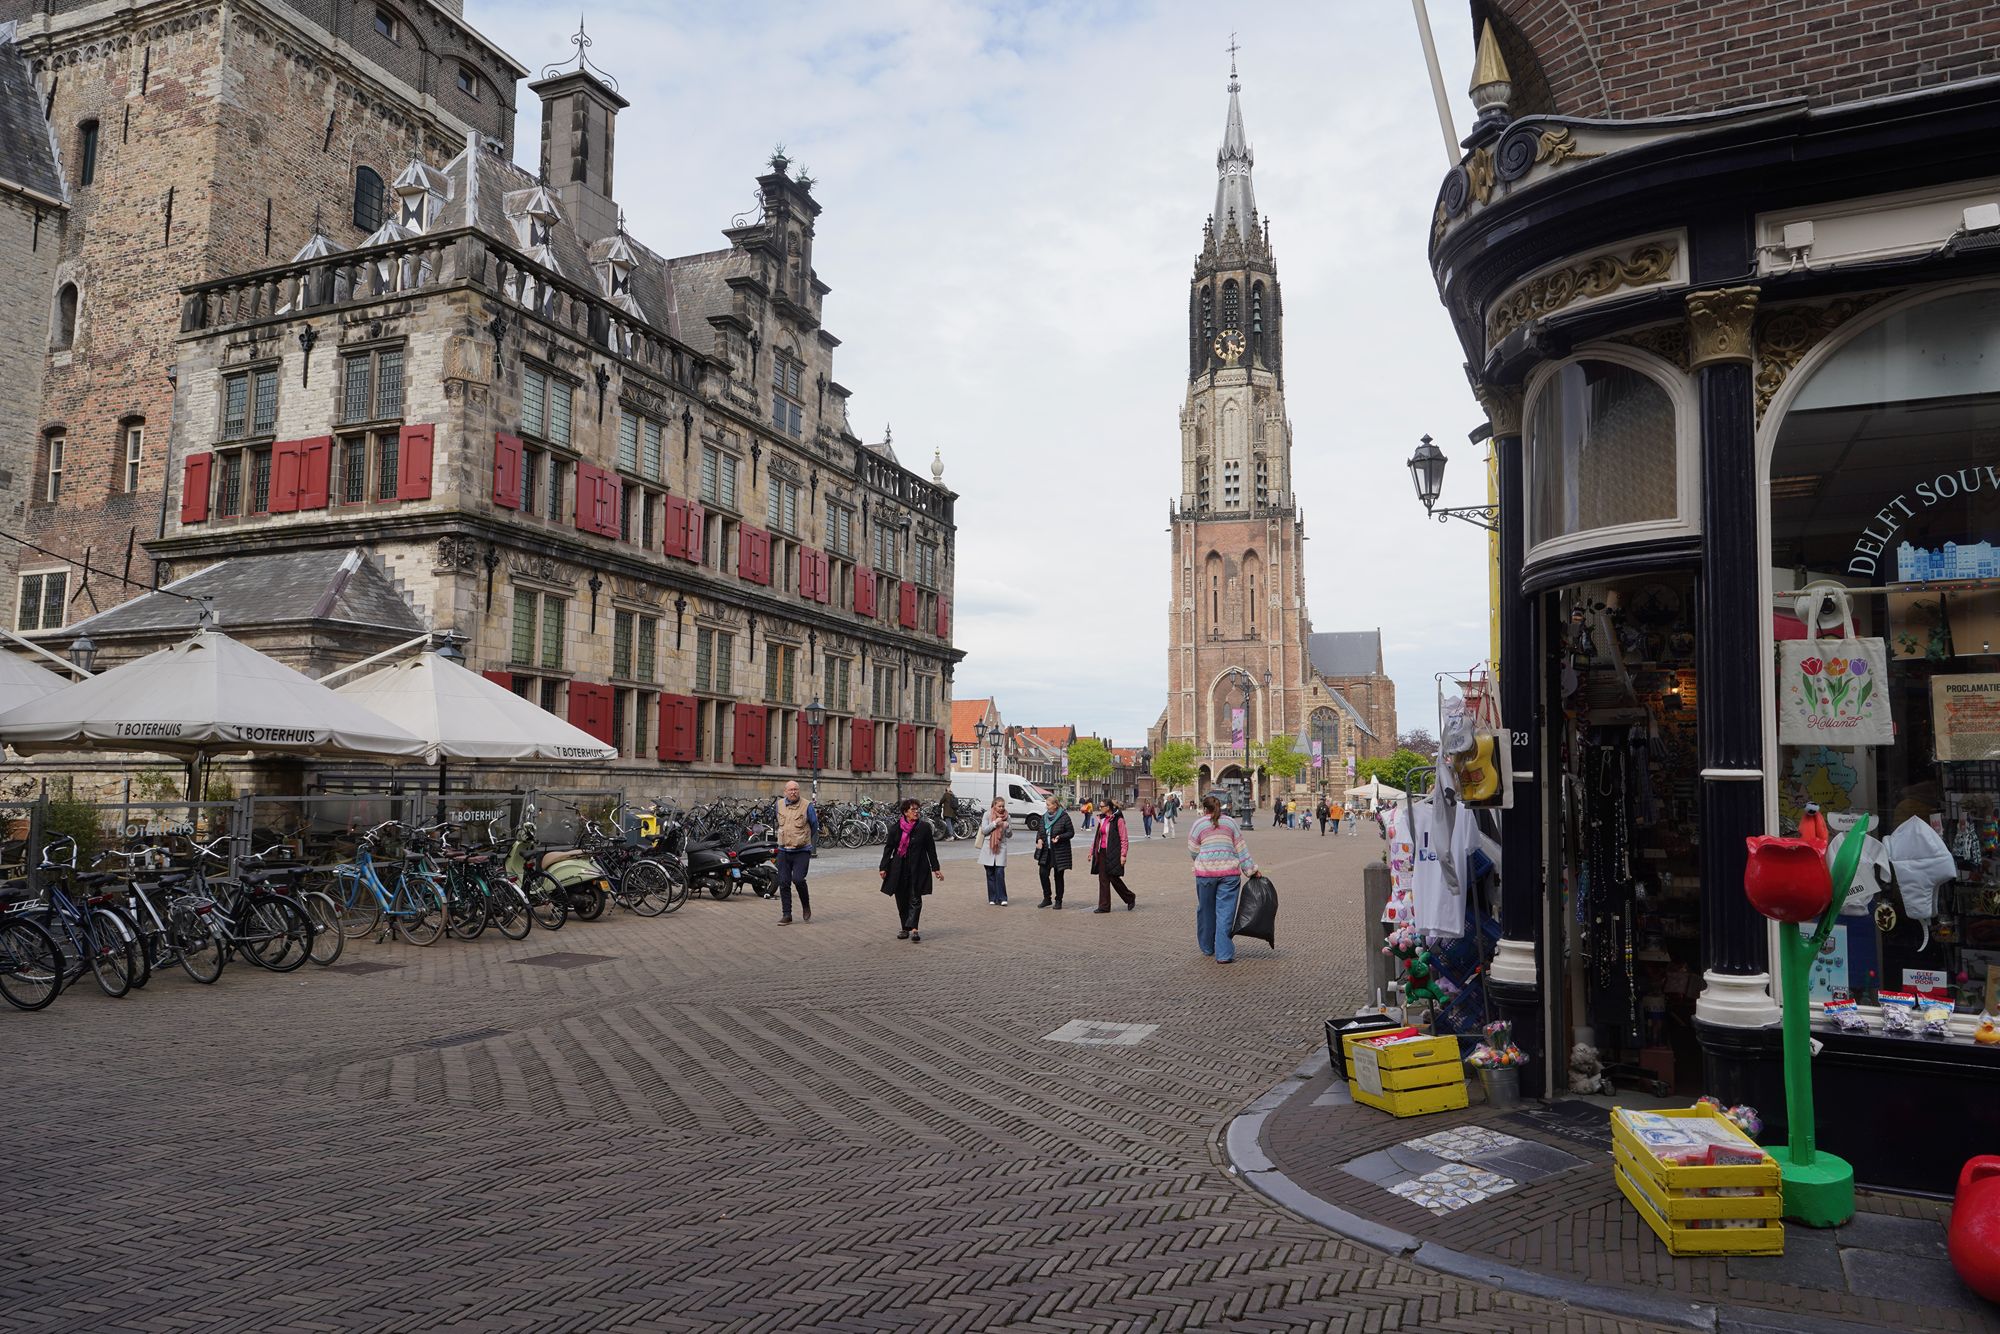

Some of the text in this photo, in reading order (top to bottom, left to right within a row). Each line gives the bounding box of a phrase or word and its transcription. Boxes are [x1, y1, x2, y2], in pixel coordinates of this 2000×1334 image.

[1848, 495, 1916, 576] DELFT
[1807, 714, 1863, 730] Holland
[124, 723, 182, 736] BOTERHUIS
[247, 726, 315, 742] BOTERHUIS
[1512, 732, 1529, 746] 23
[562, 747, 605, 758] BOTERHUIS
[458, 810, 504, 821] BOTERHUIS
